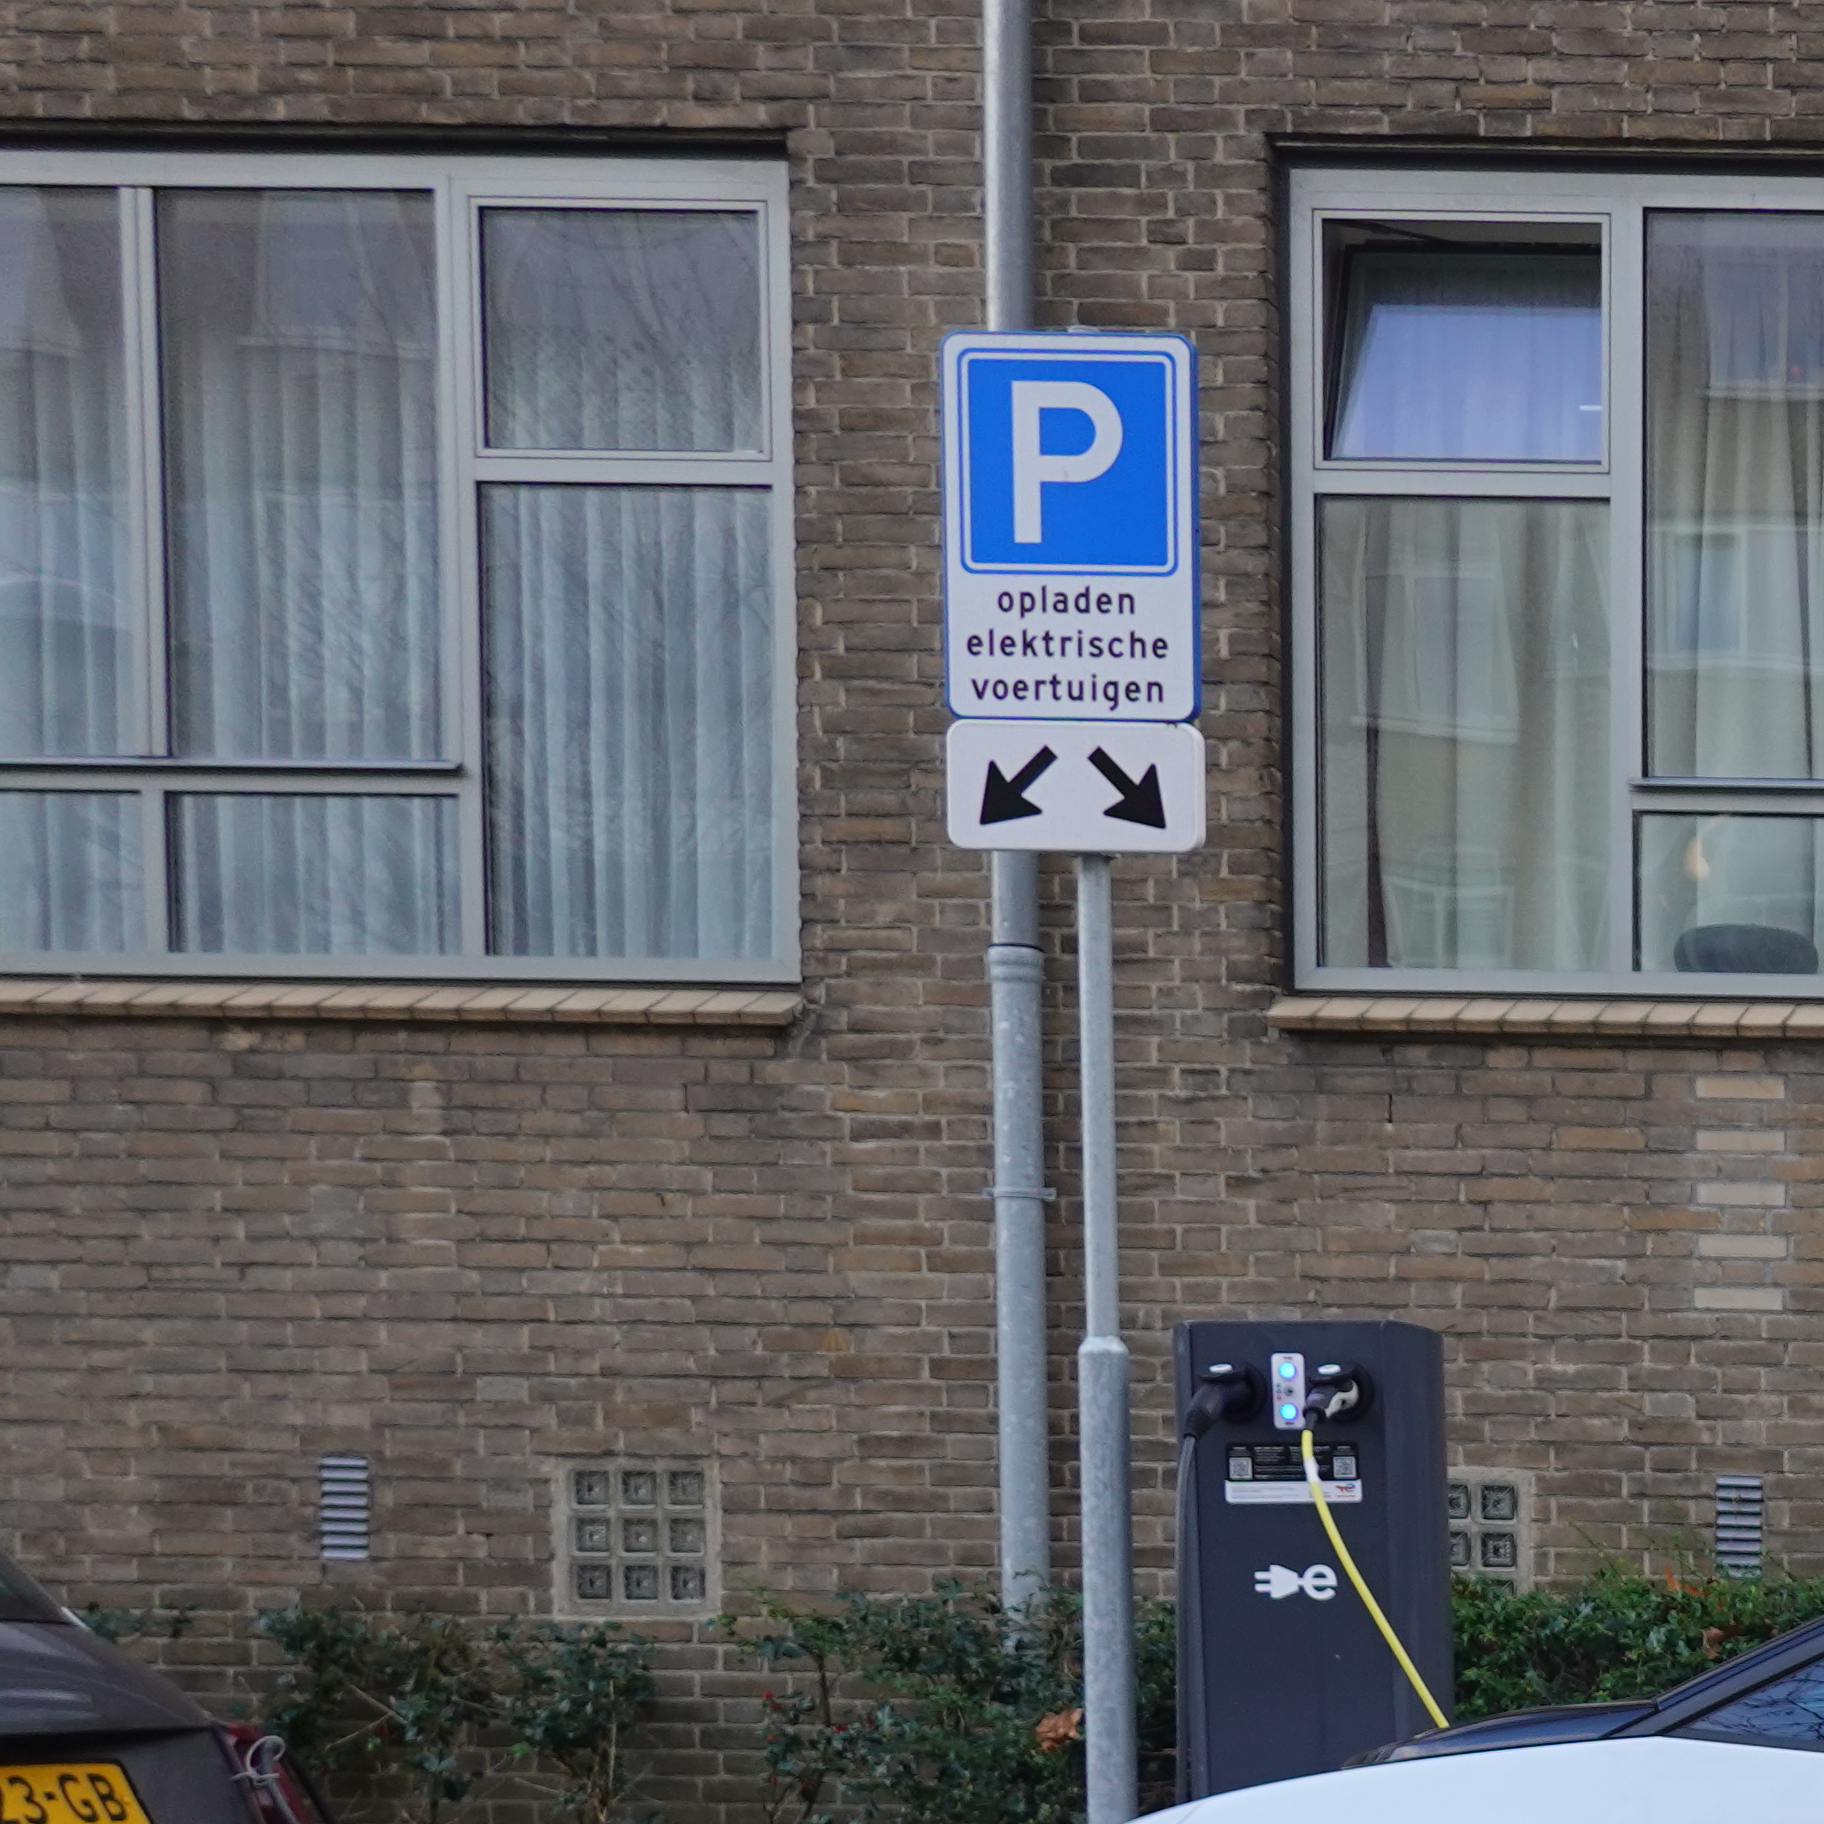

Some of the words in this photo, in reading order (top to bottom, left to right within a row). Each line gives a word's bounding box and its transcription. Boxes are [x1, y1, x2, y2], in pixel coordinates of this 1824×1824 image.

[1011, 380, 1123, 544] P
[997, 584, 1136, 619] opladen
[966, 628, 1169, 659] elektrische
[971, 673, 1164, 711] voertuigen
